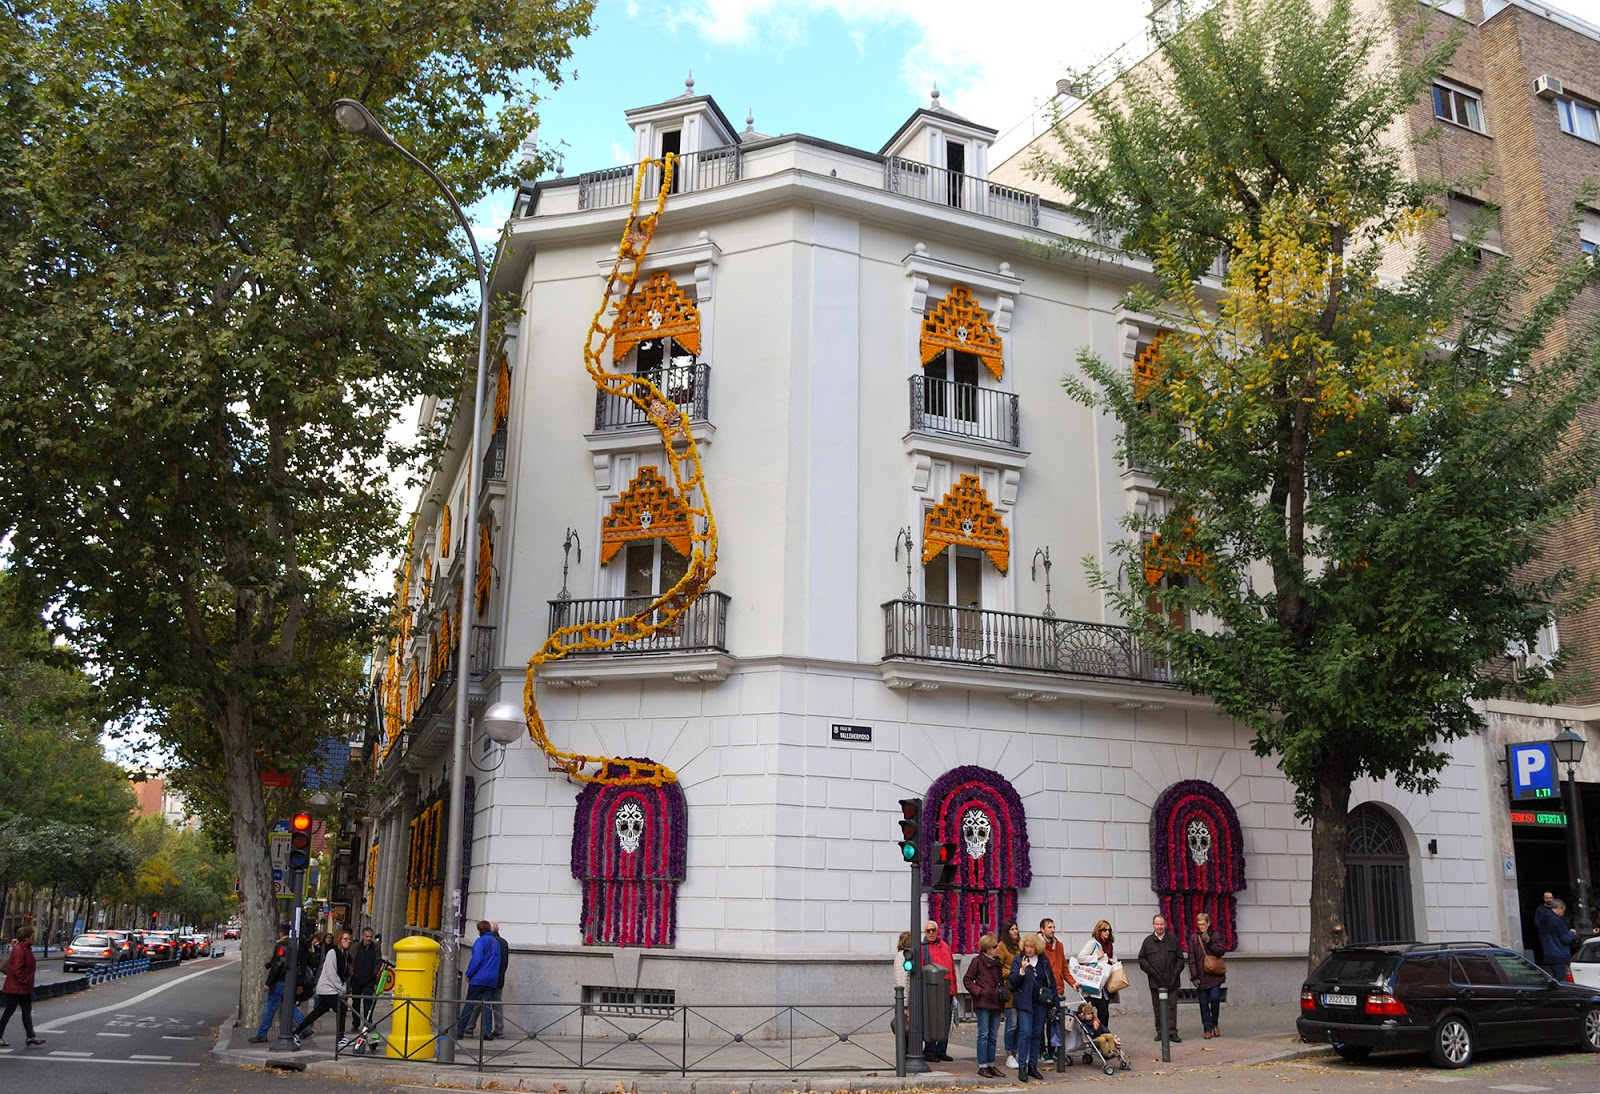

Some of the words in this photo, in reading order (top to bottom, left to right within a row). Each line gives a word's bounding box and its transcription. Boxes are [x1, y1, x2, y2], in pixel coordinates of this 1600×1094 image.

[839, 732, 870, 741] VALLEHERMOSO
[1517, 749, 1546, 786] P
[1536, 814, 1562, 824] OFERTA
[1328, 995, 1342, 1003] 2322
[115, 1014, 206, 1025] TAXI
